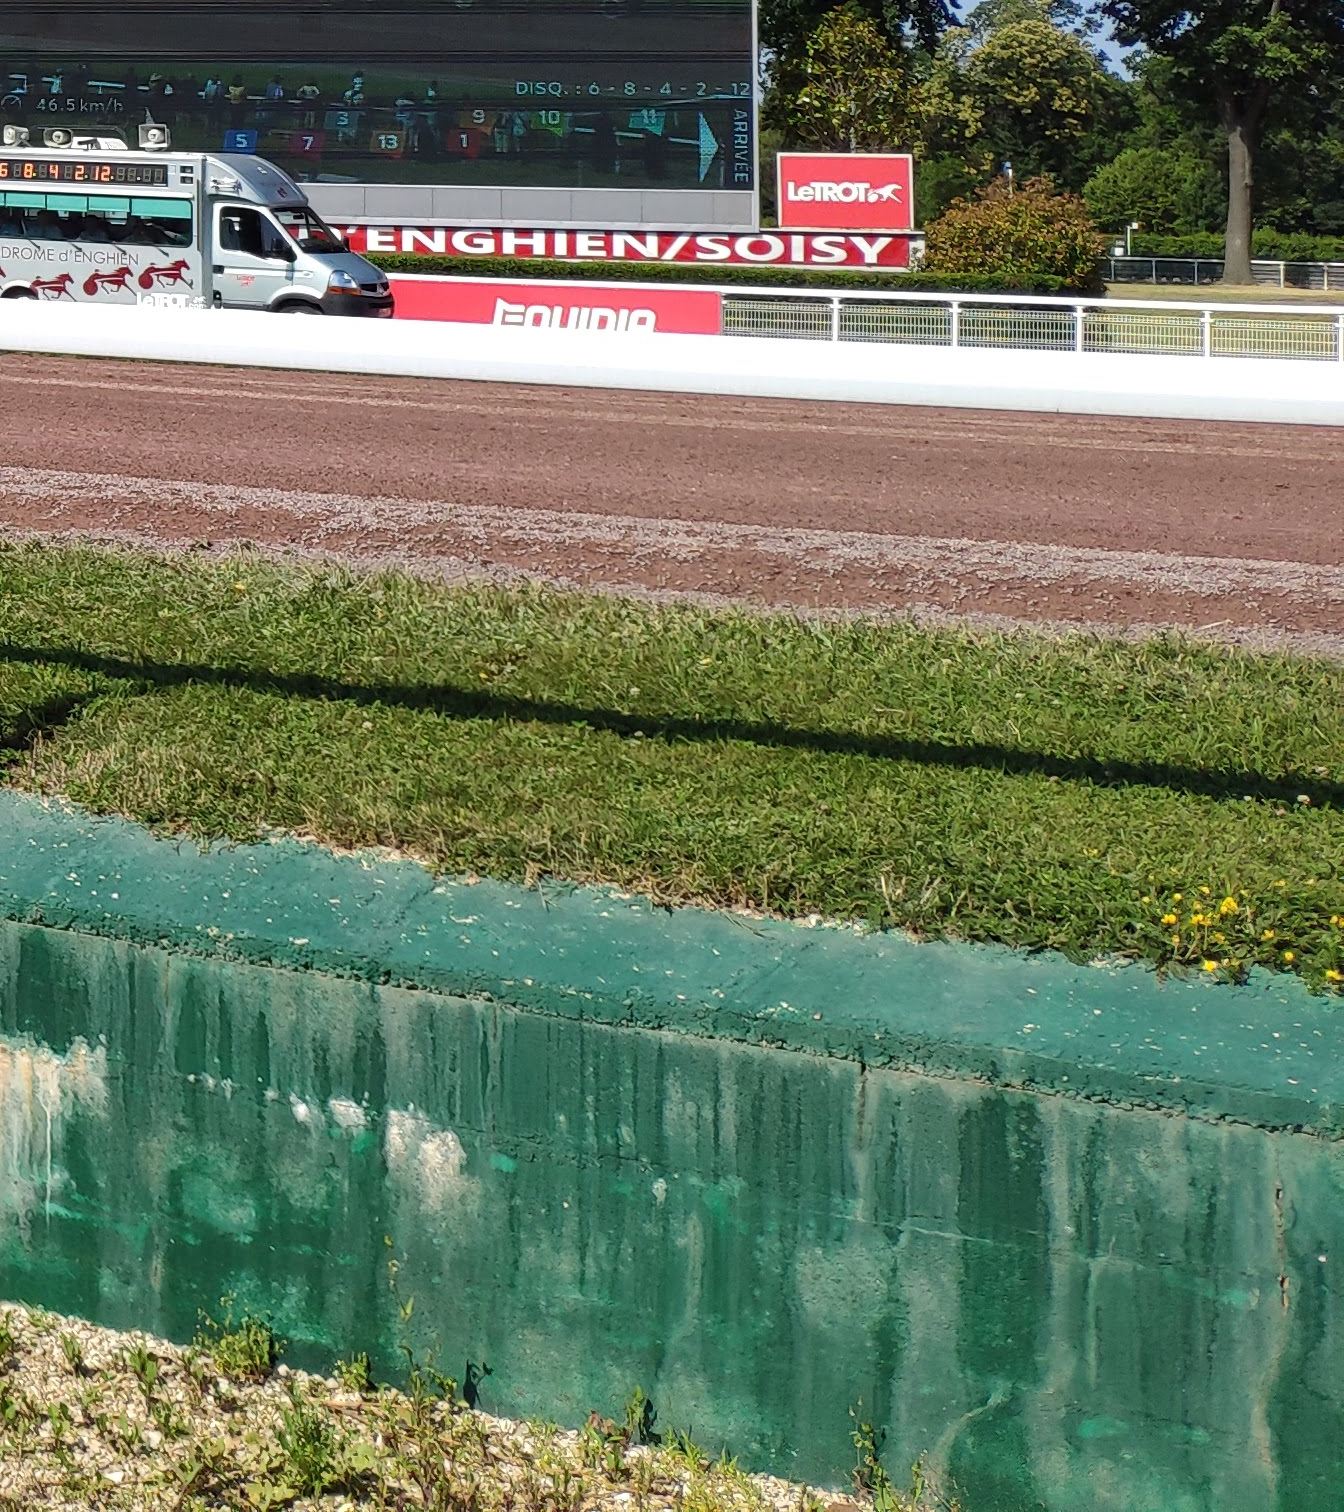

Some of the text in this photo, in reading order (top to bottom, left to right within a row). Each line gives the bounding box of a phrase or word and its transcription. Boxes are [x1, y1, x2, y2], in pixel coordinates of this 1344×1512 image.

[624, 82, 637, 96] 8
[659, 82, 672, 96] 4
[696, 82, 708, 96] 2
[730, 82, 751, 96] 12
[235, 134, 249, 148] 5
[302, 136, 314, 150] 7
[378, 134, 399, 149] 13
[459, 134, 469, 148] 1
[787, 181, 870, 202] LeTROT
[58, 248, 139, 266] d'ENGHIEN
